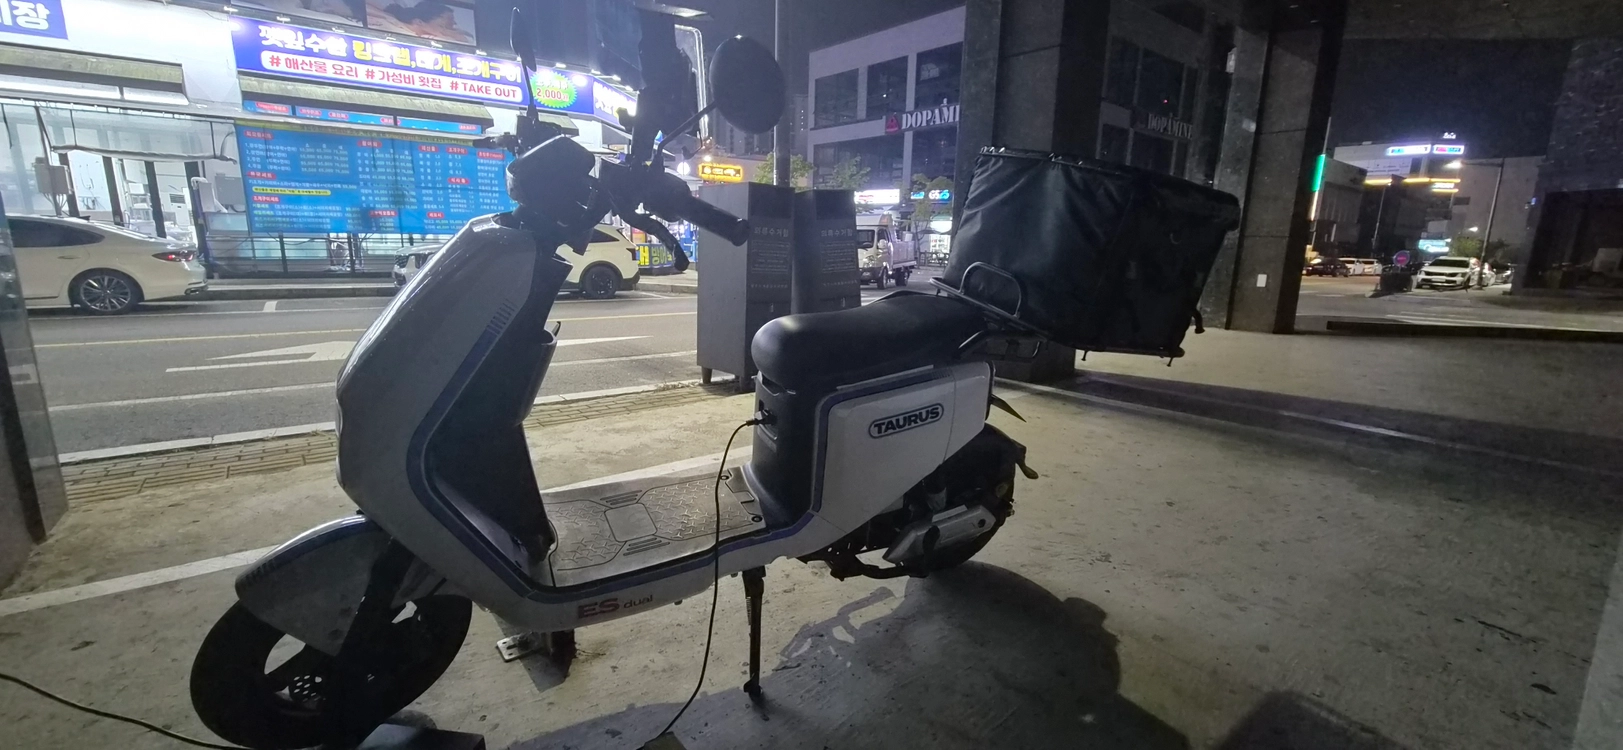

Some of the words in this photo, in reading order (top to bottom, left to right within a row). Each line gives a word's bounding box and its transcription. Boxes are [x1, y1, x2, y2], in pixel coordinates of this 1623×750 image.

[332, 63, 359, 78] 요리
[378, 70, 415, 85] 가성비
[462, 82, 492, 95] TAKE
[495, 87, 517, 99] OUT
[873, 406, 940, 435] TAURUS
[579, 598, 620, 618] ES
[623, 594, 653, 609] dual
